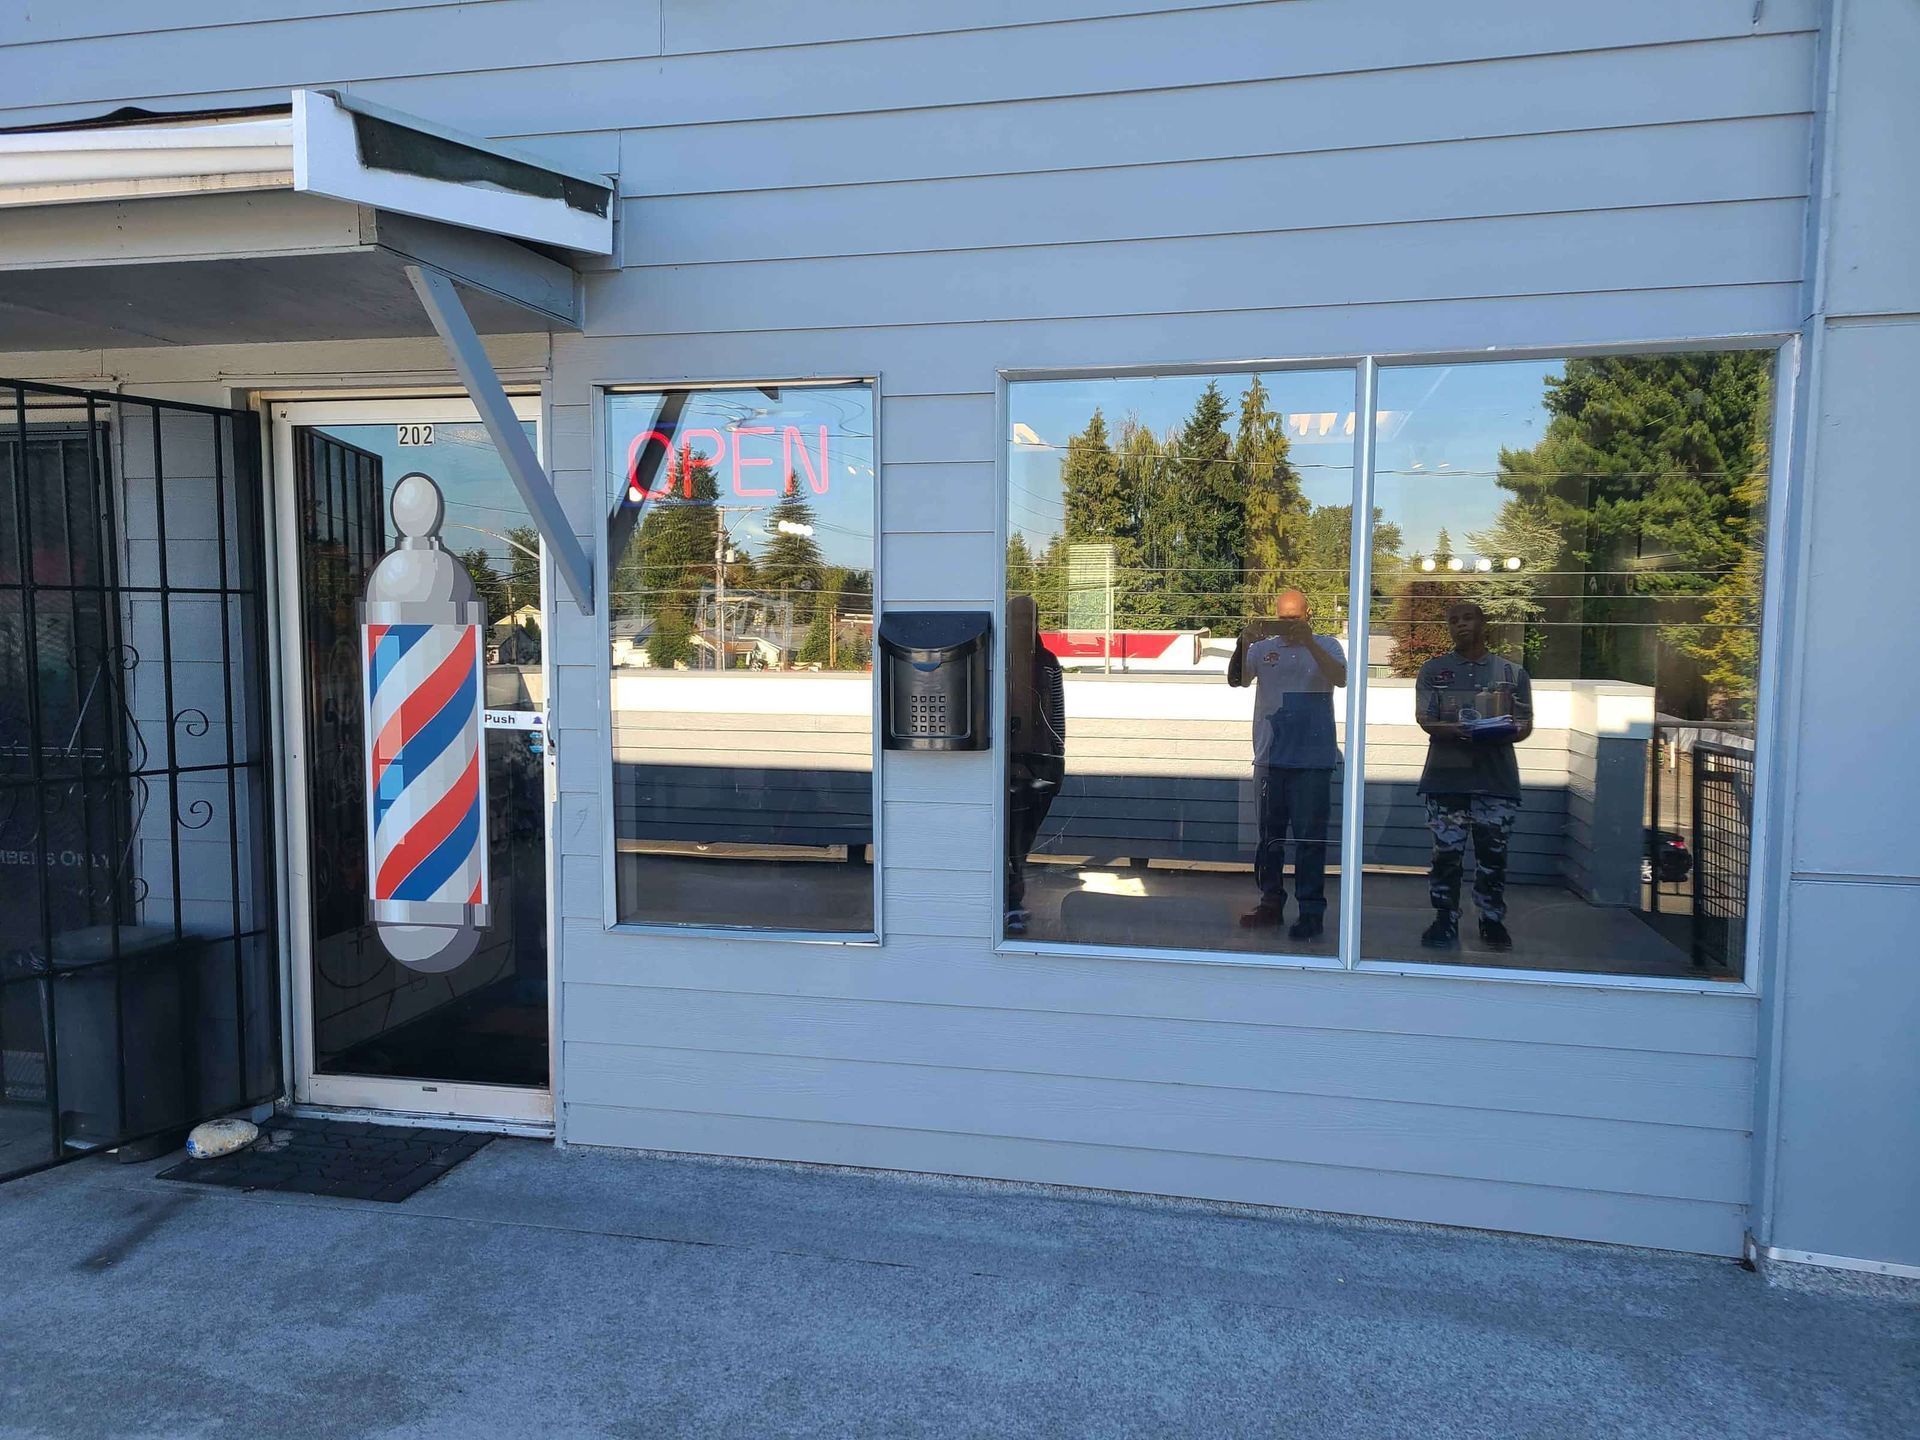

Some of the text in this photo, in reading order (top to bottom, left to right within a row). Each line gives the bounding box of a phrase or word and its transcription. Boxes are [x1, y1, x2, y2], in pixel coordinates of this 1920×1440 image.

[399, 426, 432, 445] 202
[627, 424, 829, 499] OPEN
[484, 713, 516, 724] Push
